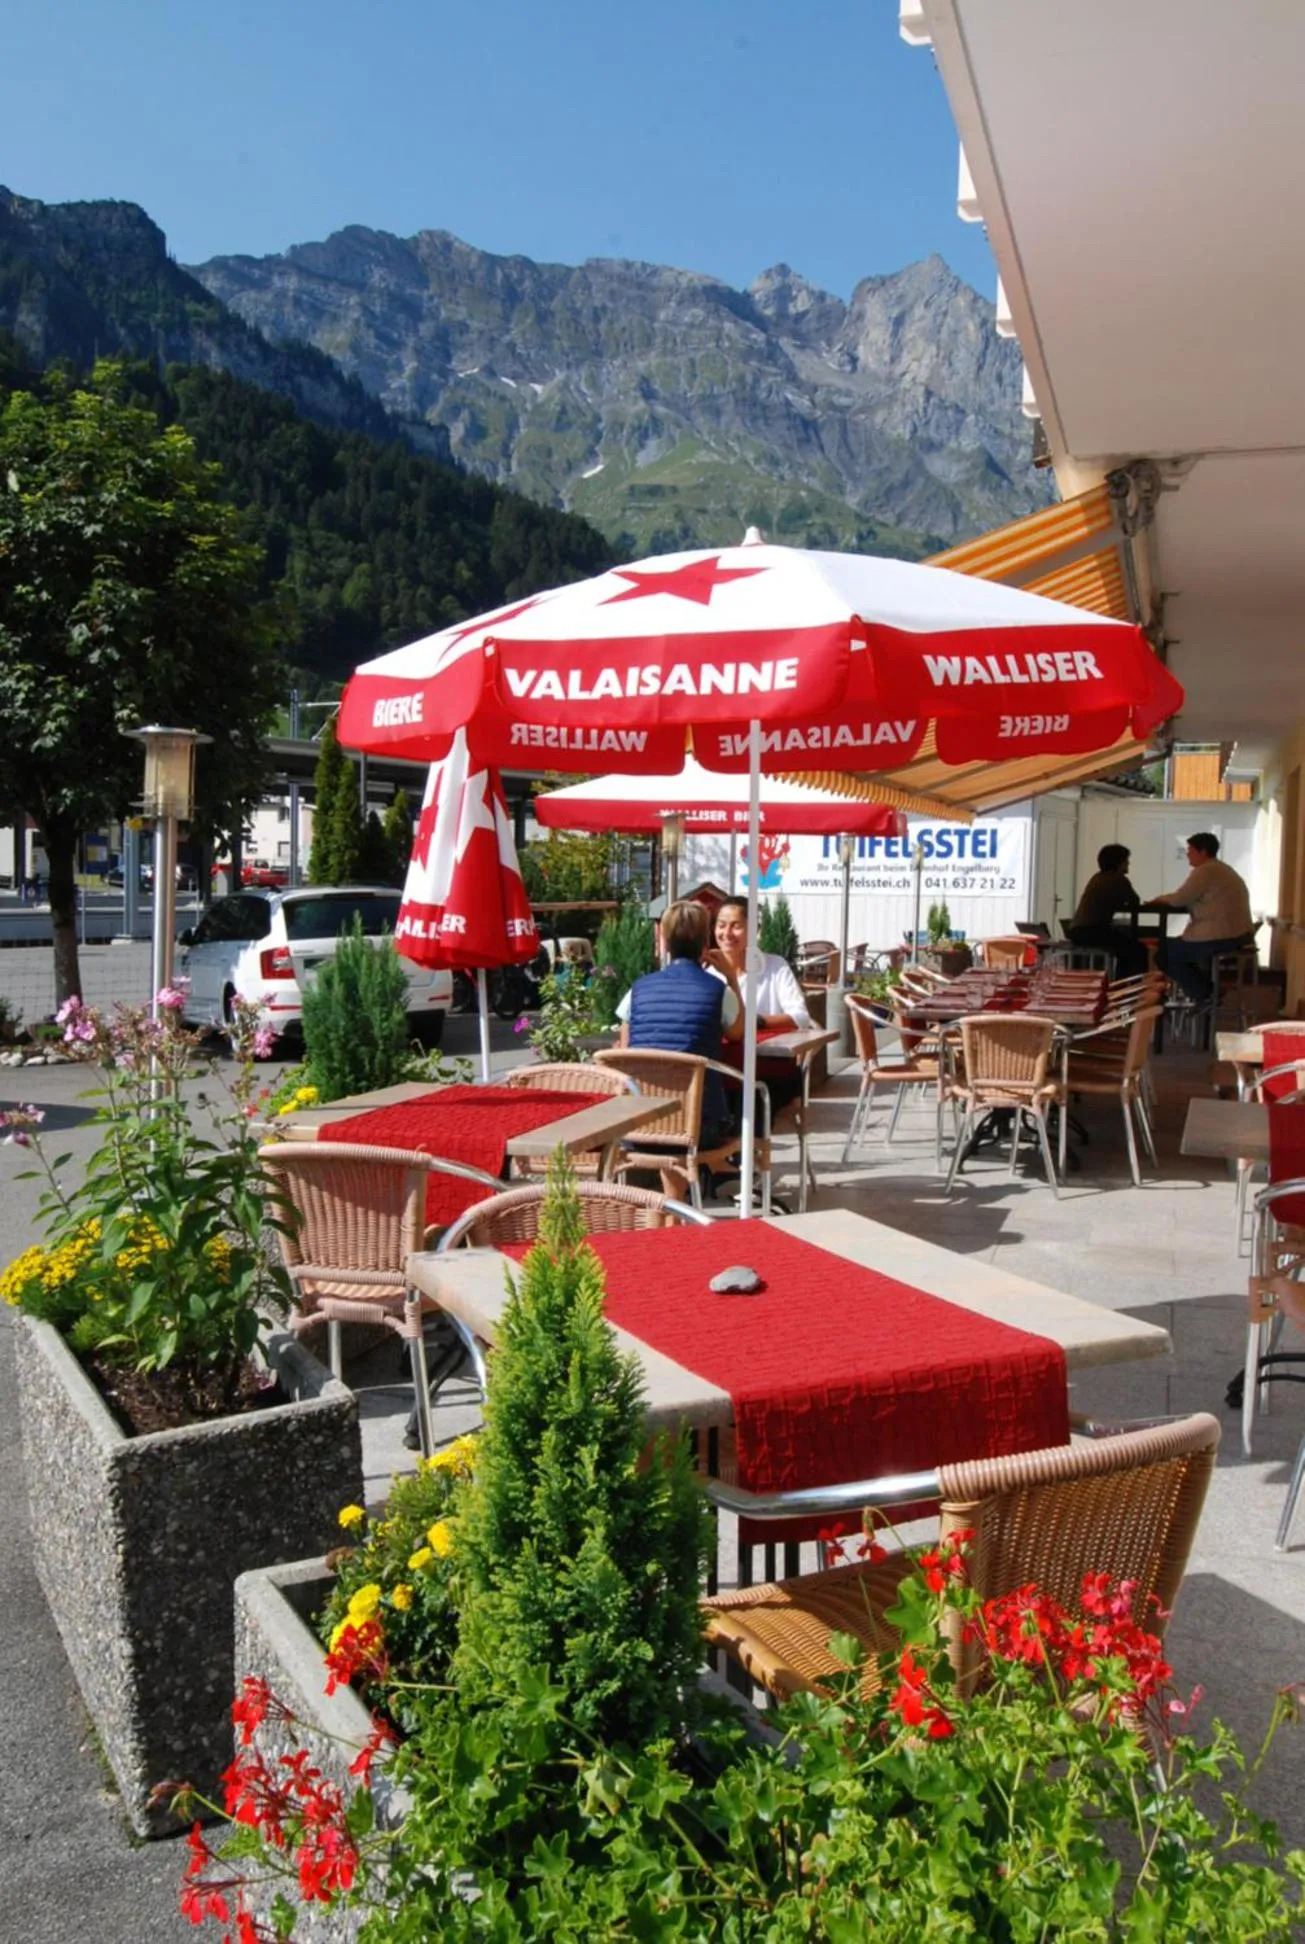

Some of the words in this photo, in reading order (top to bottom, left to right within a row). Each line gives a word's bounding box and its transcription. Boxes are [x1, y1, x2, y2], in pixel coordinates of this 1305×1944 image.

[504, 657, 800, 701] VALAISANNE
[922, 651, 1104, 686] WALLISER
[372, 691, 424, 728] BIERE
[925, 877, 946, 889] 041
[952, 877, 976, 889] 637
[980, 877, 995, 889] 21
[1000, 877, 1016, 890] 22
